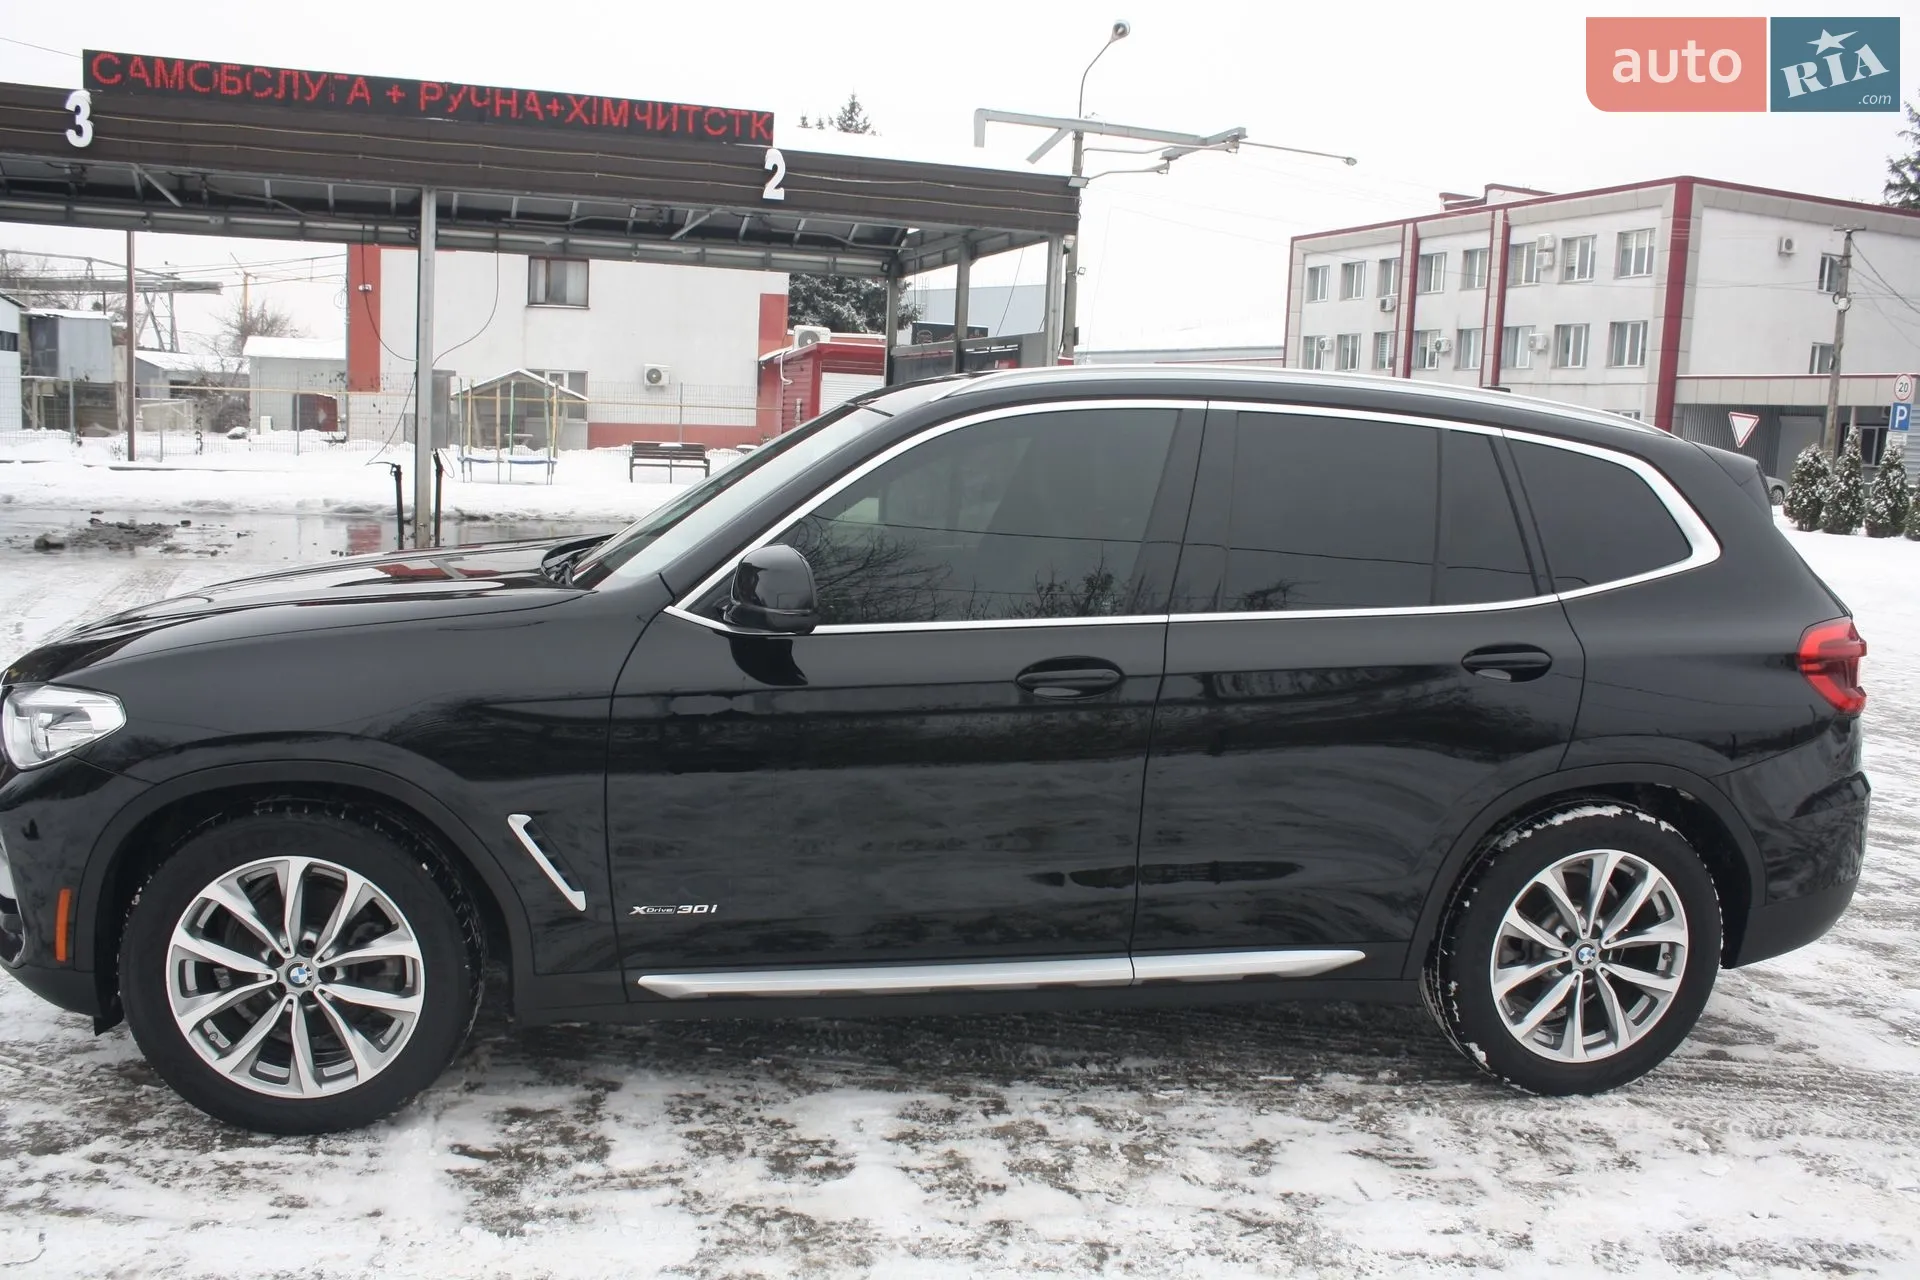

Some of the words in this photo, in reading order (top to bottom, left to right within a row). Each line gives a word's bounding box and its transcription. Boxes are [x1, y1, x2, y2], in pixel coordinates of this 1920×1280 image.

[65, 89, 93, 147] 3
[763, 148, 786, 200] 2
[1899, 382, 1909, 393] 20
[1895, 405, 1908, 428] P
